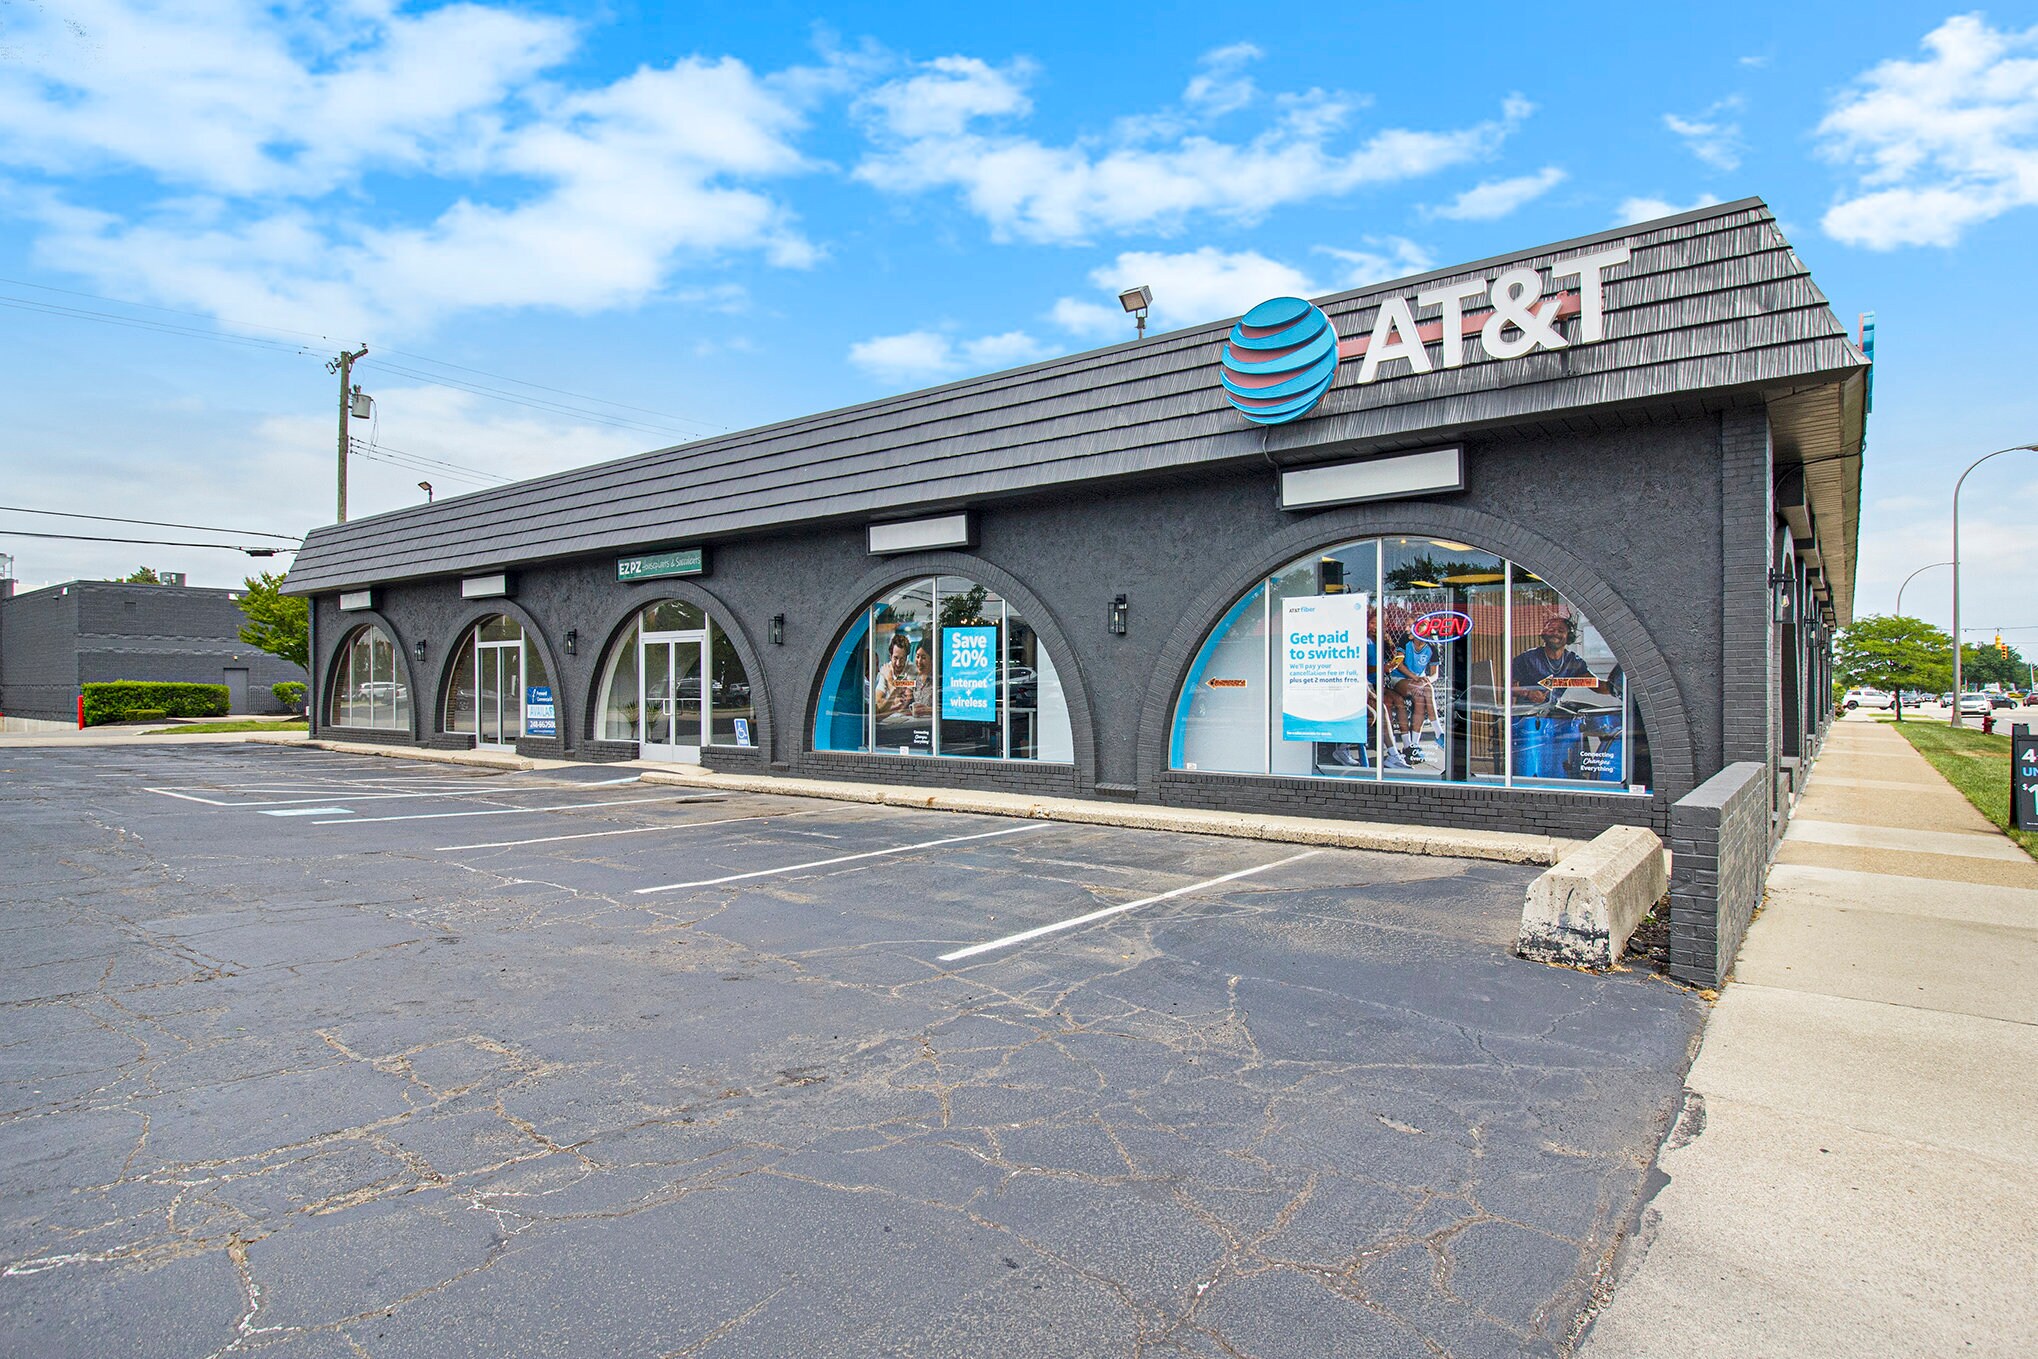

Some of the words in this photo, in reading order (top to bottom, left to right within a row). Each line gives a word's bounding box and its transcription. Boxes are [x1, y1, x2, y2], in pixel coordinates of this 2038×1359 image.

[1357, 246, 1630, 384] AT&T
[1415, 617, 1468, 637] OPEN
[951, 632, 987, 649] Save
[1290, 632, 1315, 645] Get
[1318, 630, 1349, 647] paid
[951, 649, 988, 668] 20%
[1289, 648, 1305, 660] to
[1308, 646, 1360, 660] switch!
[950, 677, 988, 688] internet
[950, 697, 988, 708] wireless
[1580, 751, 1614, 759] Connecting
[1582, 757, 1611, 766] Changes
[2021, 748, 2038, 763] 4
[1580, 765, 1614, 773] Everything
